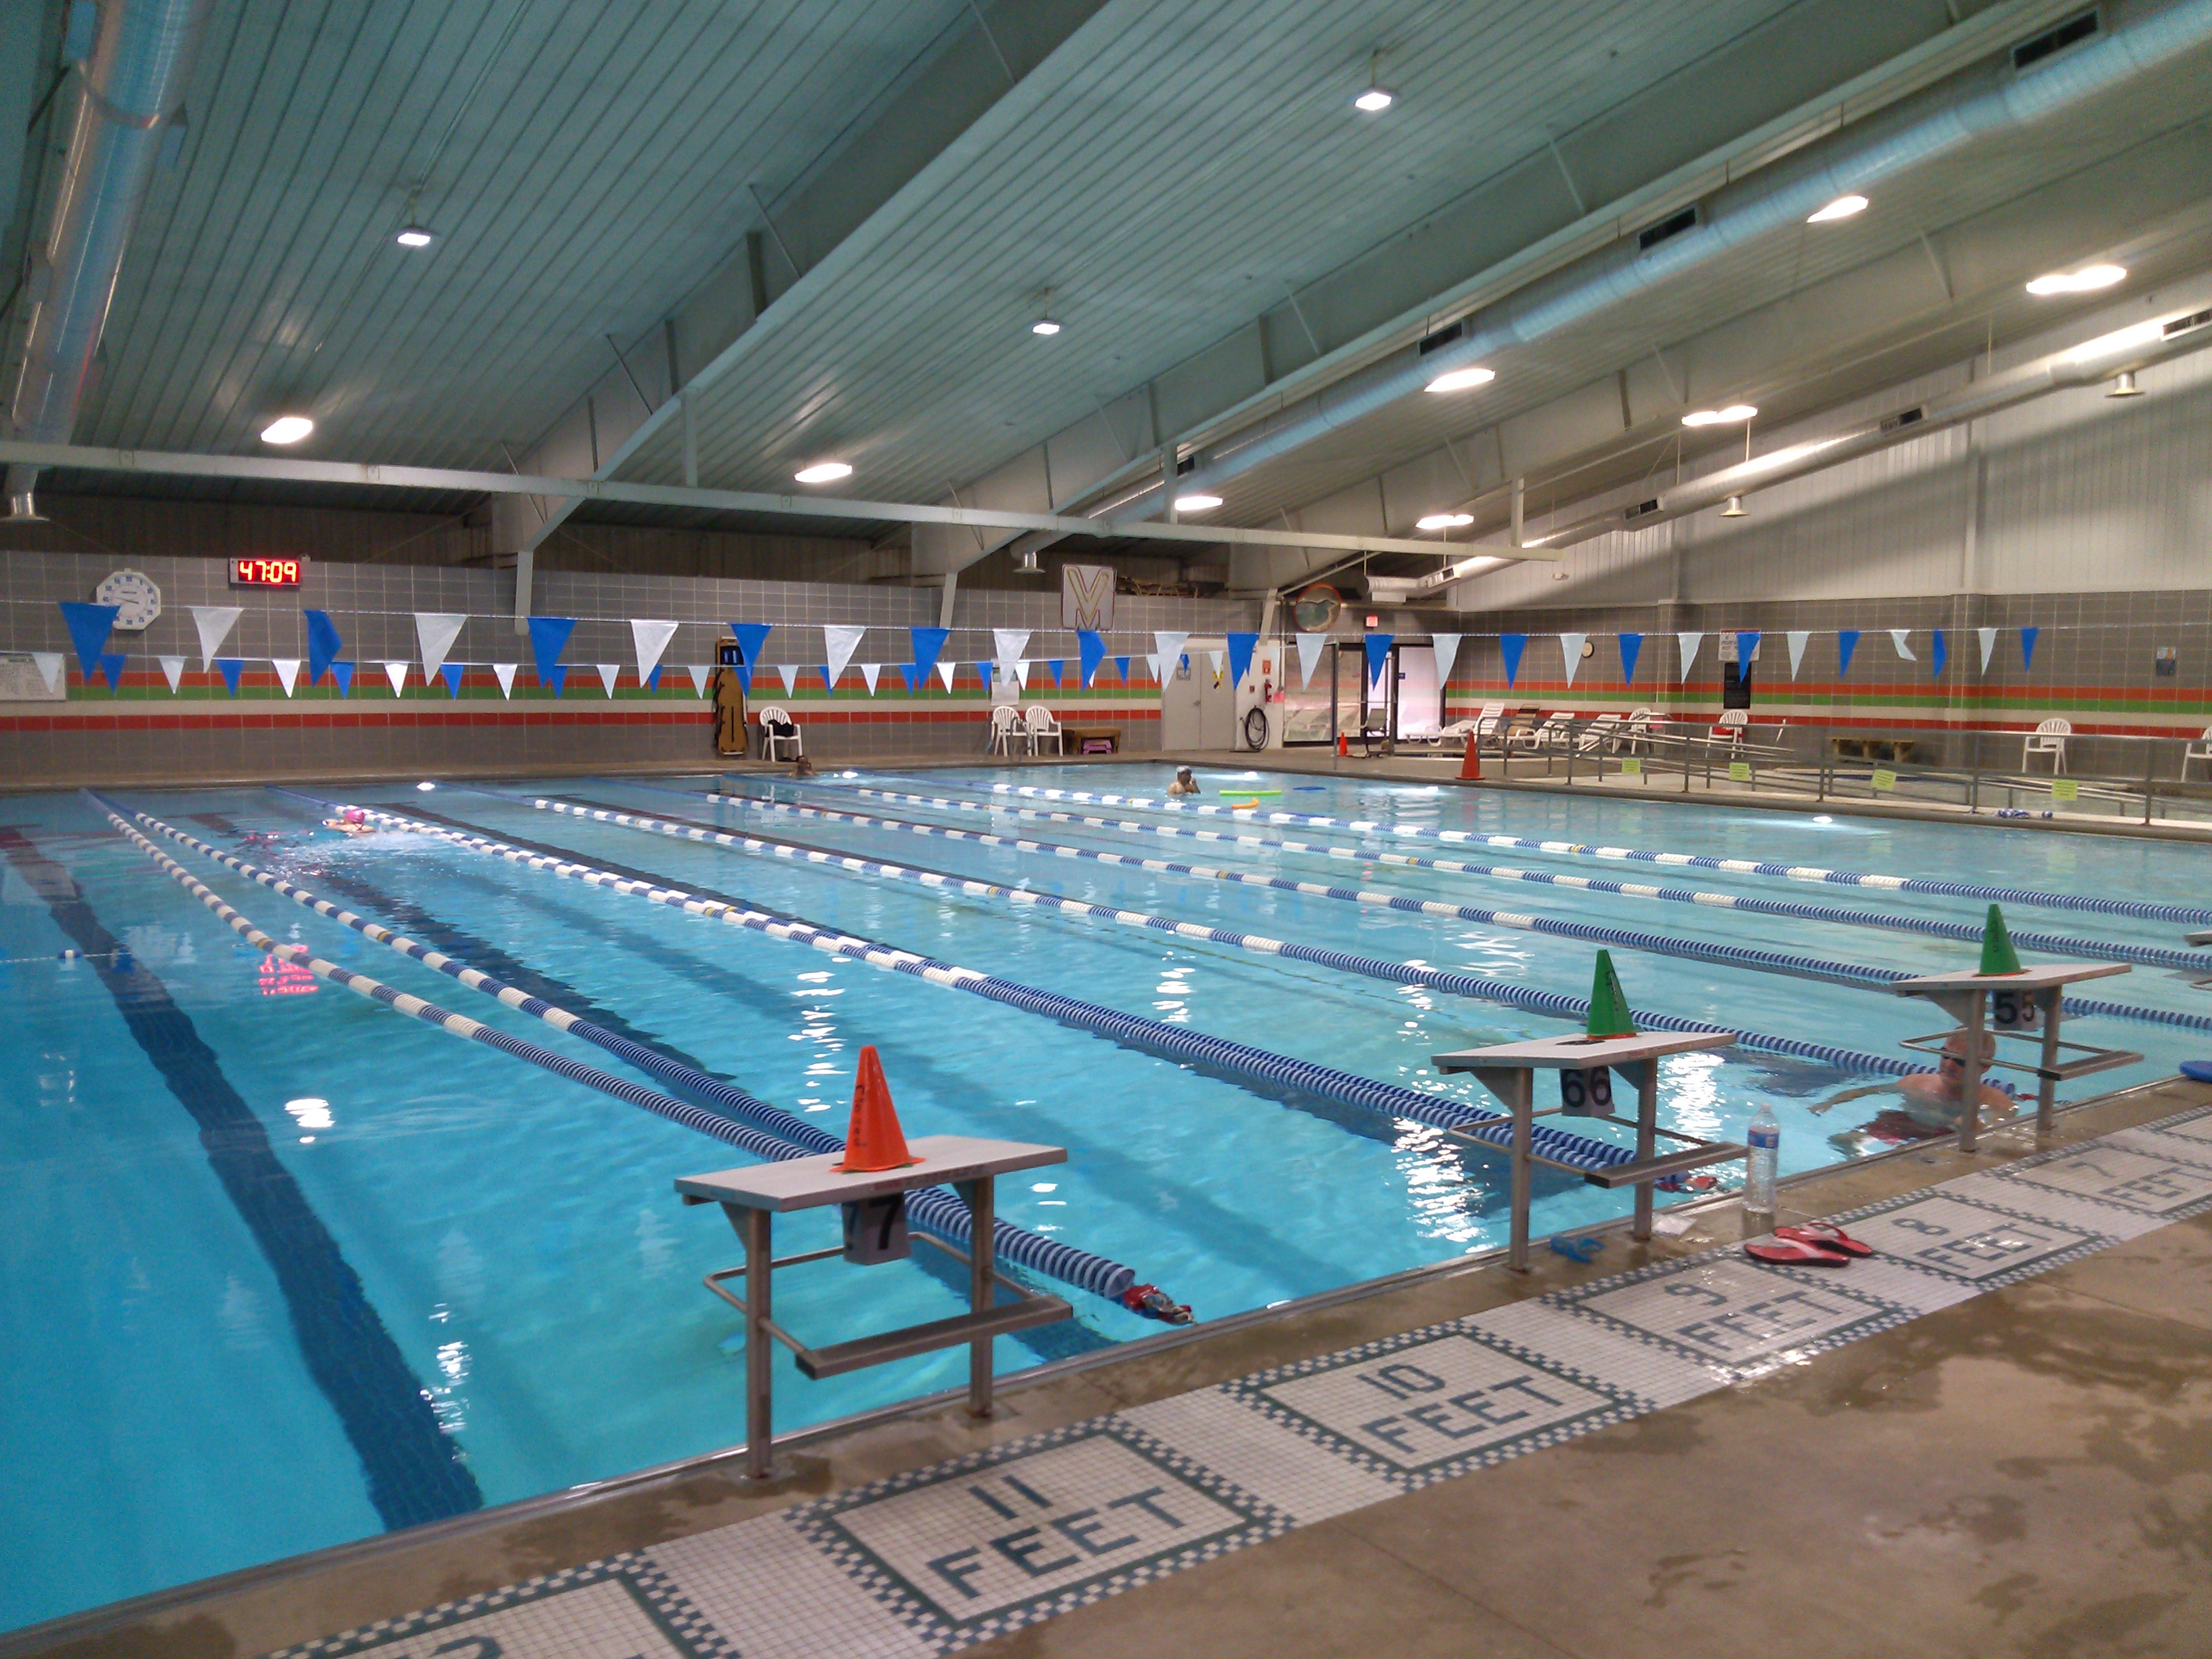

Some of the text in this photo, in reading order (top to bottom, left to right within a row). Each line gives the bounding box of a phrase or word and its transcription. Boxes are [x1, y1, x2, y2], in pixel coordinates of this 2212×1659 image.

[239, 560, 297, 583] 47:09
[1994, 992, 2018, 1024] 5
[2022, 991, 2034, 1022] 5
[1564, 1069, 1586, 1108] 6
[1590, 1066, 1612, 1106] 6
[2067, 1162, 2119, 1178] 7
[2100, 1167, 2212, 1205] FEET
[869, 1194, 904, 1250] 7
[1892, 1218, 1949, 1236] 8
[1914, 1223, 2053, 1271] FEET
[1664, 1284, 1728, 1306] 9
[1675, 1291, 1841, 1351] FEET
[1356, 1364, 1446, 1401] 10
[1359, 1375, 1564, 1454] FEET
[968, 1475, 1053, 1520] 11
[926, 1487, 1185, 1599] FEET
